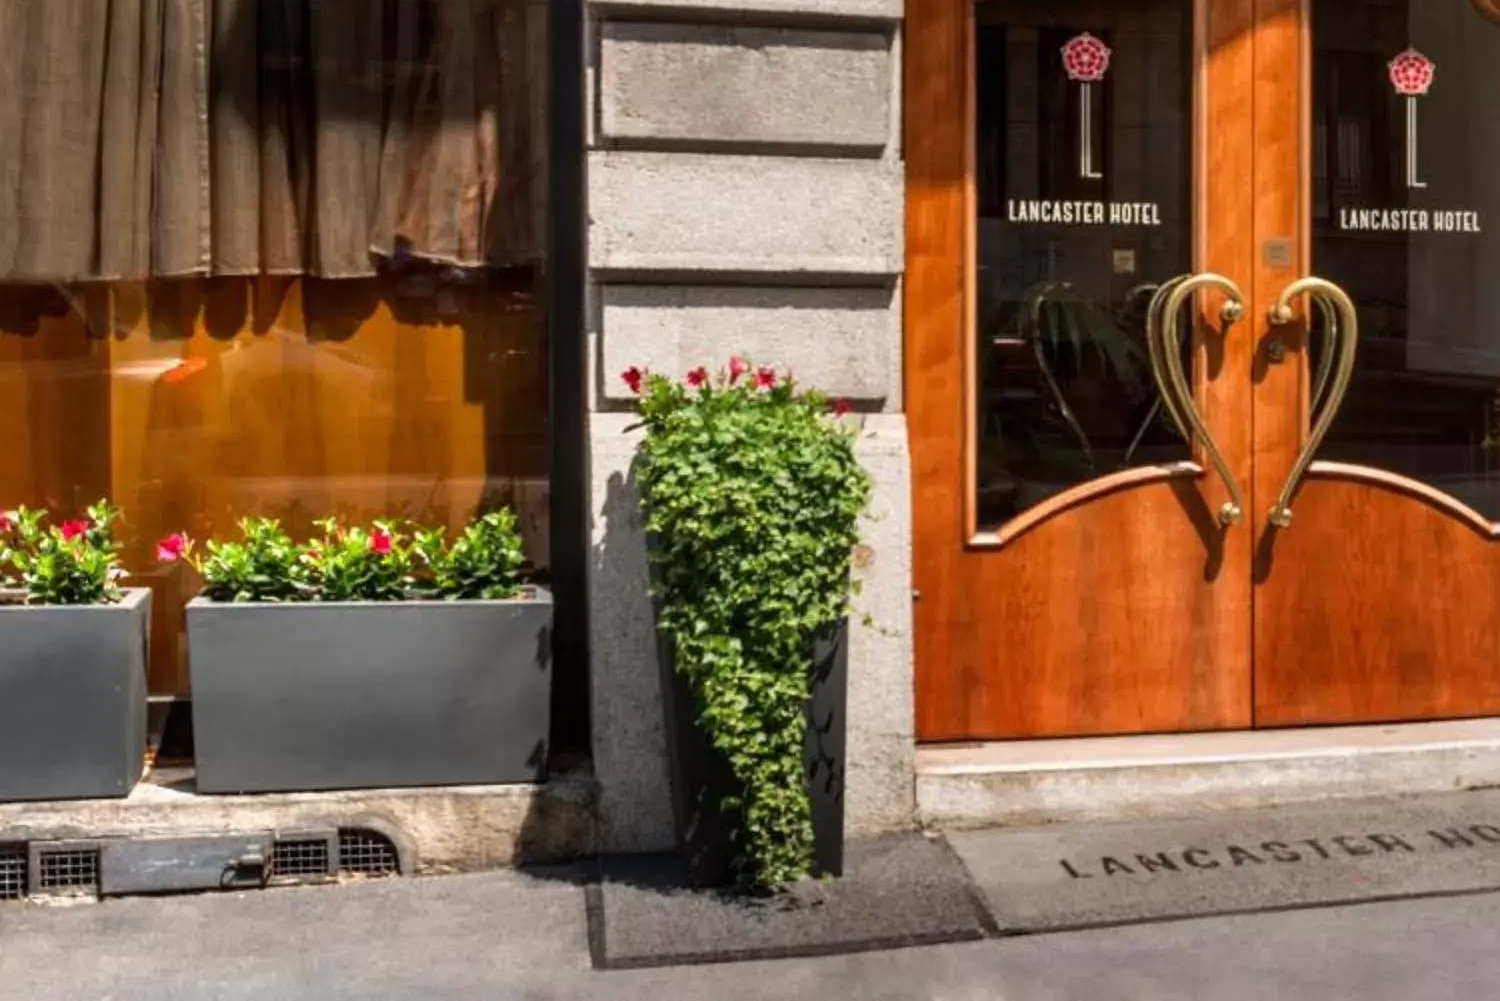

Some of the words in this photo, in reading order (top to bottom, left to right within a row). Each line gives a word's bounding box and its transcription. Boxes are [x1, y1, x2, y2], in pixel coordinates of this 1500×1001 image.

[1008, 199, 1105, 225] LANCASTER
[1109, 202, 1161, 225] HOTEL
[1340, 208, 1429, 232] LANCASTER
[1433, 210, 1482, 233] HOTEL
[1059, 832, 1416, 879] LANCASTER
